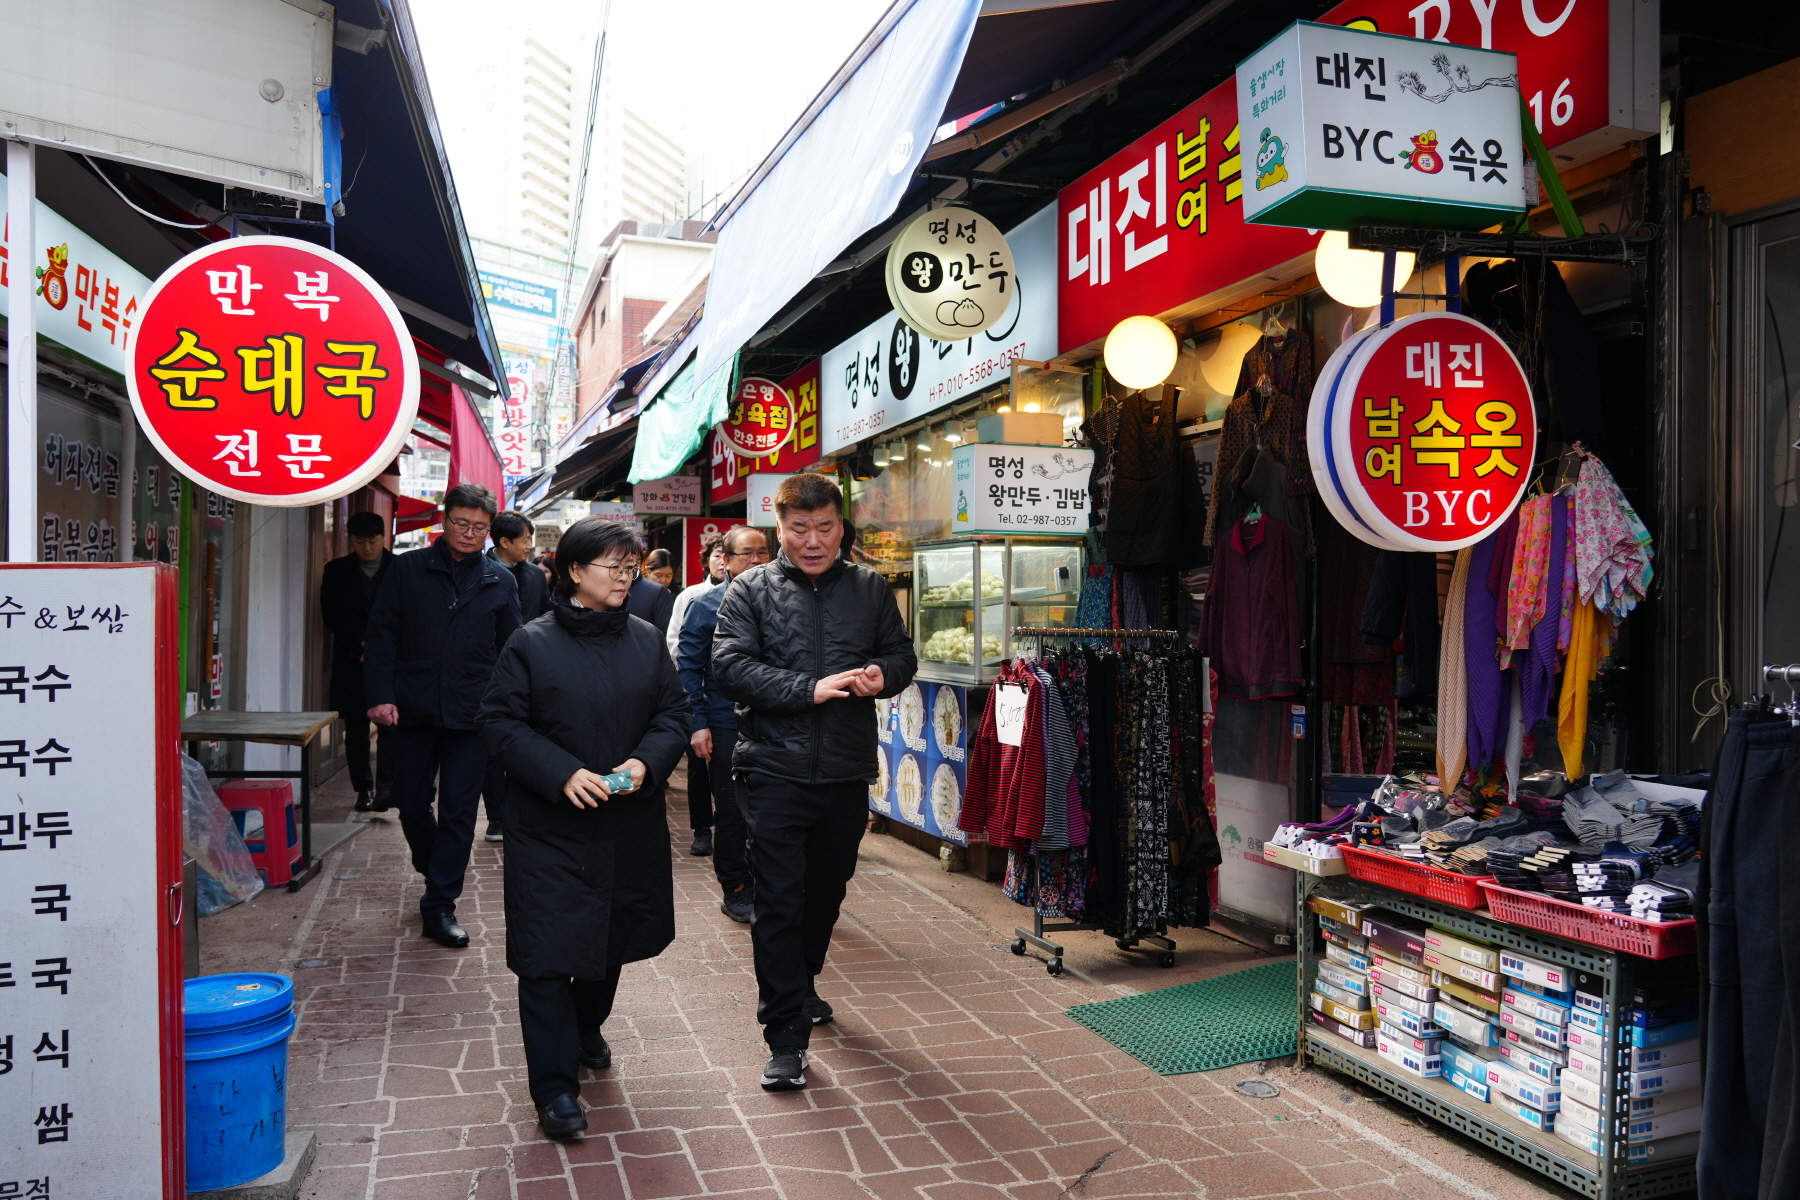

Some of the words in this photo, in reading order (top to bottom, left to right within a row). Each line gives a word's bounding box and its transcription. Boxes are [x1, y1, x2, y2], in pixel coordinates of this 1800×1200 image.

[1250, 58, 1285, 98] 솔샘시장
[1316, 52, 1386, 101] 대진
[1252, 84, 1286, 118] 특화거리
[1323, 123, 1394, 164] BYC
[1449, 136, 1508, 185] 속옷
[929, 218, 977, 244] 명성
[1068, 141, 1168, 286] 대진
[149, 328, 389, 421] 순대국
[845, 340, 881, 409] 명성
[1406, 341, 1484, 388] 대진
[742, 383, 775, 402] 은행
[733, 429, 778, 448] 한우전문
[1410, 398, 1523, 479] 속옷
[45, 433, 119, 497] 허파전골
[989, 456, 1024, 479] 명성
[640, 492, 659, 501] 강화
[671, 493, 696, 503] 건강원
[1403, 489, 1491, 527] BYC
[42, 515, 117, 562] 닭볶음탕
[1017, 514, 1077, 526] 02-987-0357
[34, 607, 58, 629] &
[62, 604, 130, 634] 보쌈
[31, 884, 71, 922] 국
[34, 1103, 73, 1144] 쌈
